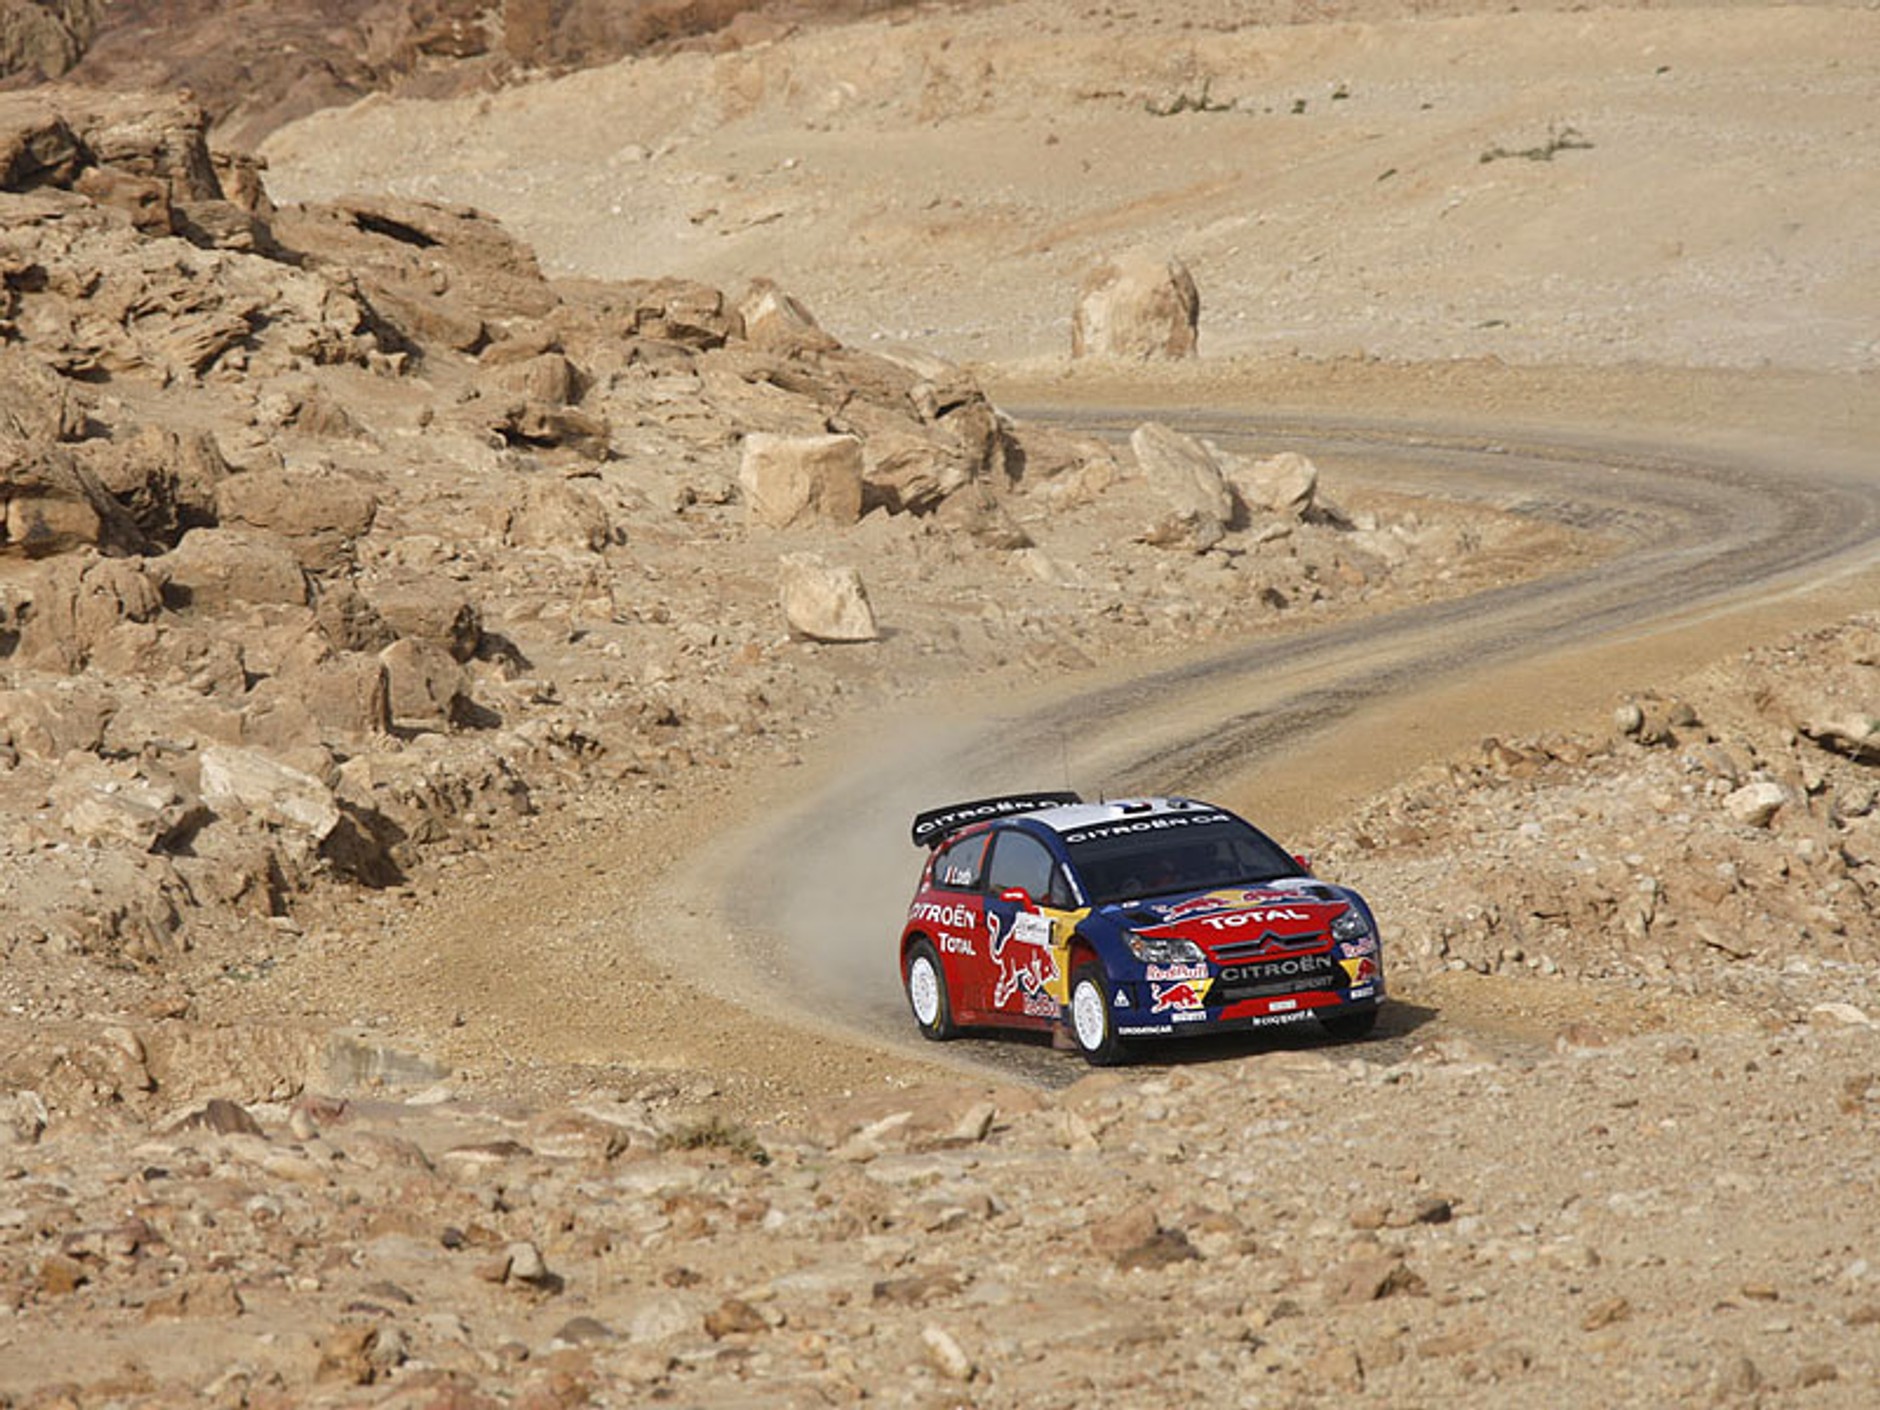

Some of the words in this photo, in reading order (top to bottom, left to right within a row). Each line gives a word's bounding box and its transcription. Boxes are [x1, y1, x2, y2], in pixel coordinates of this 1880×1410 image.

[1065, 818, 1189, 843] CITROËN
[1201, 909, 1310, 931] TOTAL
[1220, 954, 1332, 982] CITROËN
